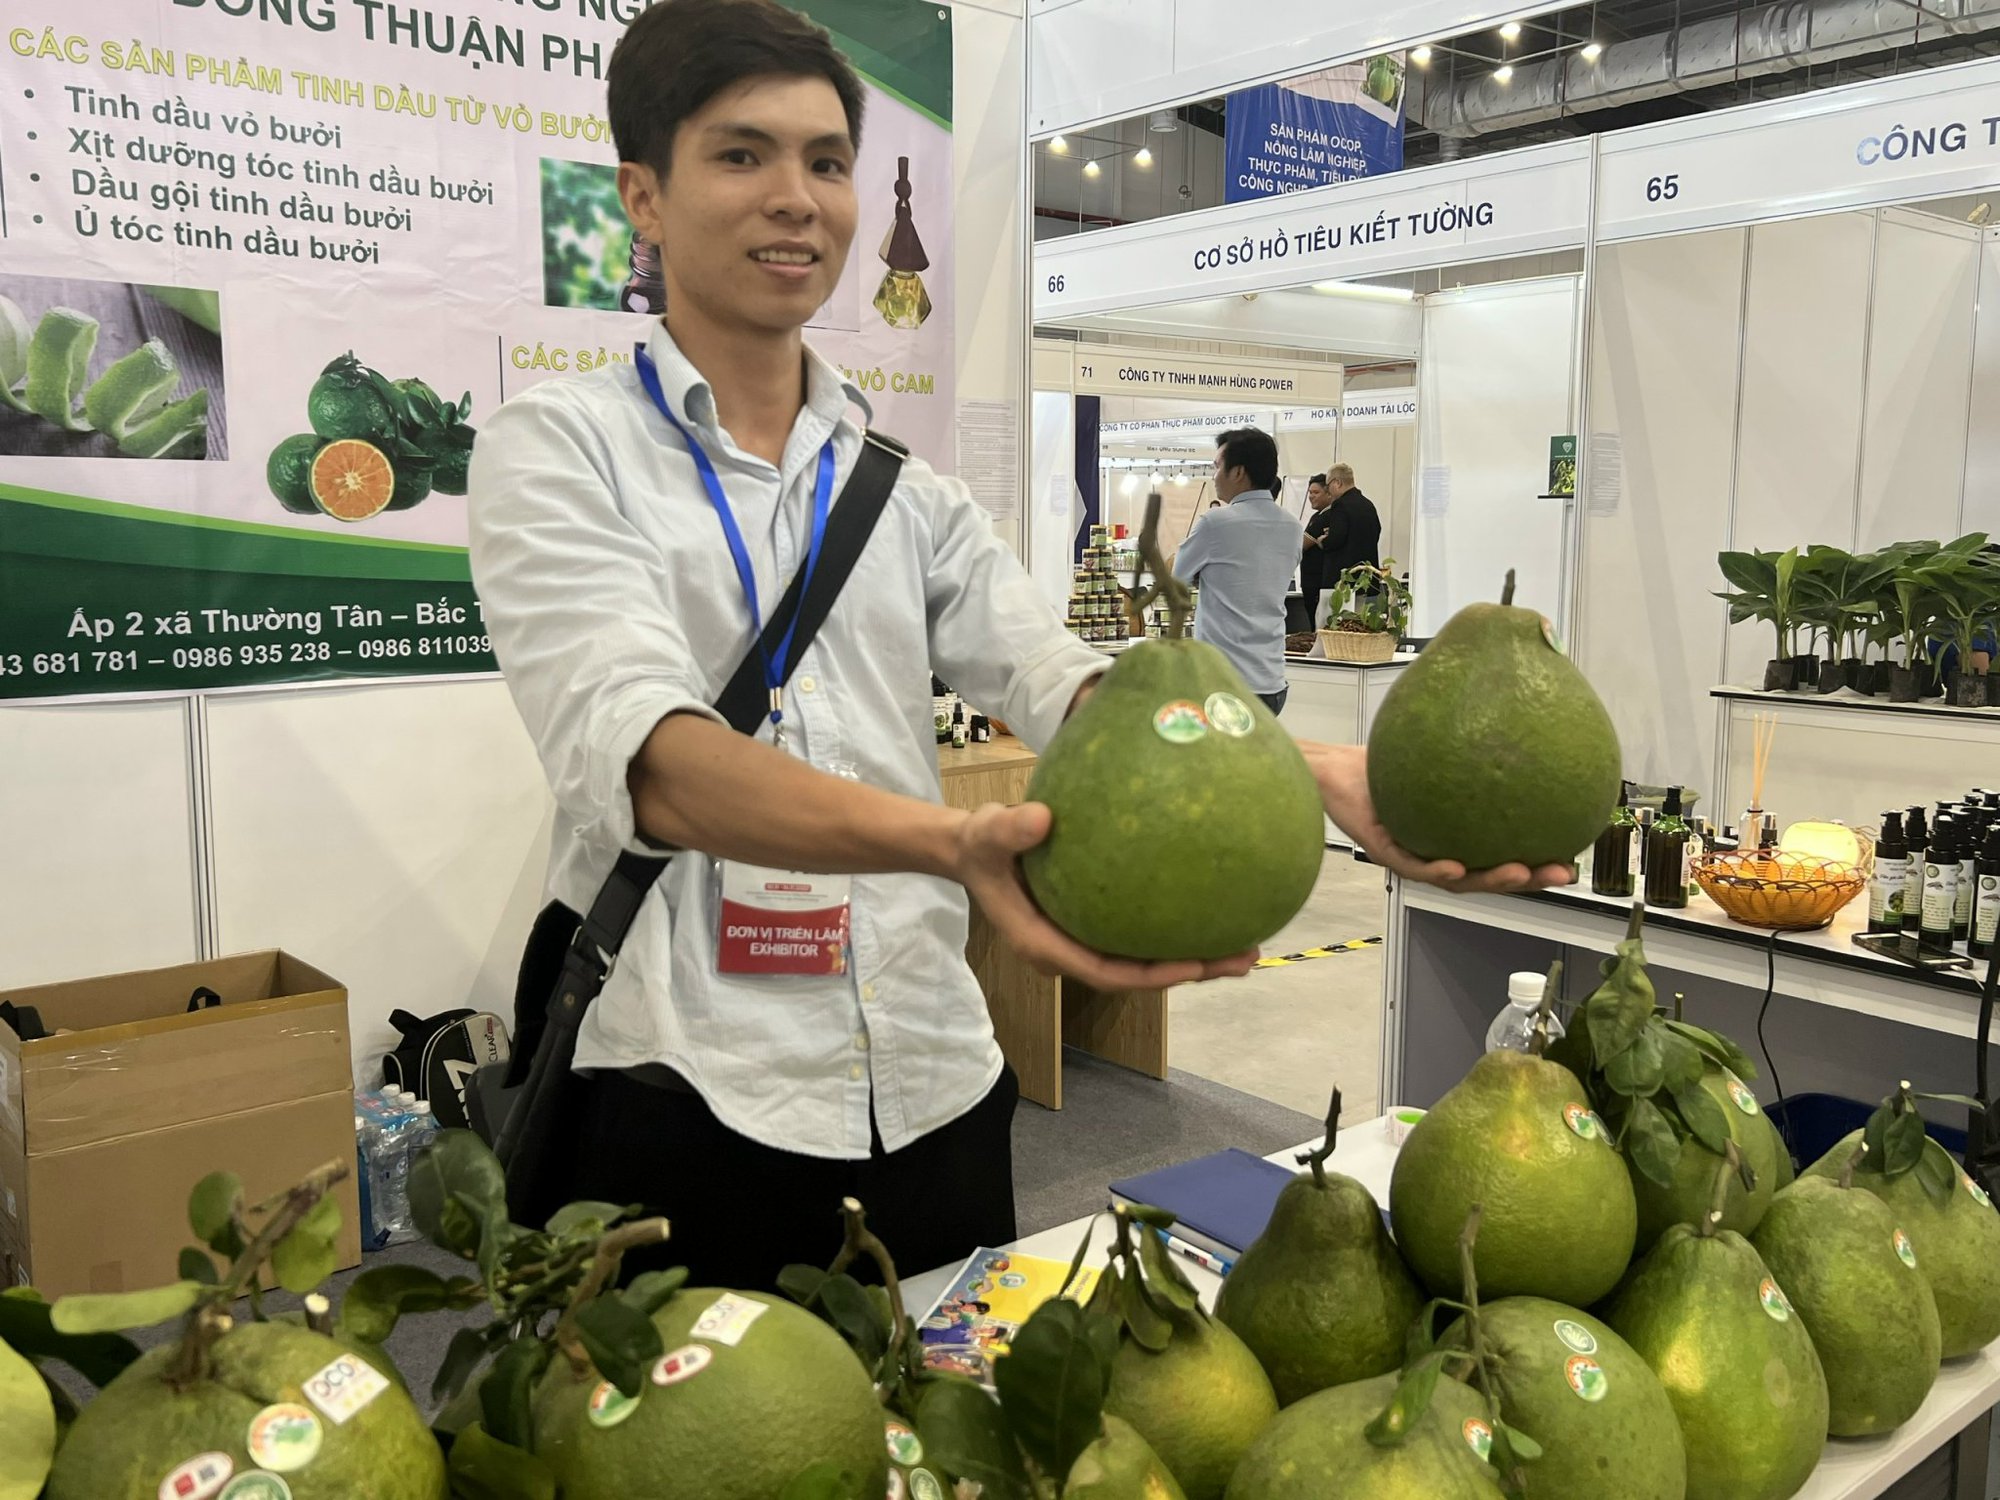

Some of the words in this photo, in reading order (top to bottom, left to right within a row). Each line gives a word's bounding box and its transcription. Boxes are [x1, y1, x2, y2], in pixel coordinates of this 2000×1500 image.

[173, 0, 335, 31] NG
[352, 1, 524, 70] THUẬN
[543, 33, 608, 81] PH
[9, 26, 89, 64] CÁC
[101, 39, 174, 76] SẢN
[186, 56, 282, 95] PHẨM
[291, 71, 364, 107] TINH
[373, 83, 436, 118] DẦU
[444, 94, 486, 125] TỪ
[492, 103, 532, 132] VỎ
[64, 85, 140, 120] Tinh
[152, 95, 210, 130] dầu
[221, 111, 259, 138] vỏ
[270, 115, 341, 149] bưởi
[1270, 122, 1293, 140] SẢN
[68, 127, 115, 163] Xịt
[126, 136, 235, 179] dưỡng
[245, 152, 294, 180] tóc
[303, 160, 359, 189] tinh
[369, 164, 420, 196] dầu
[430, 175, 493, 205] bưởi
[1248, 156, 1281, 174] THỰC
[1264, 140, 1297, 159] NÔNG
[1300, 147, 1324, 164] LÂM
[1646, 174, 1680, 202] 65
[1856, 124, 1967, 165] CÔNG
[72, 166, 138, 201] Dầu
[150, 180, 199, 212] gội
[209, 187, 269, 216] tinh
[279, 191, 334, 223] dầu
[345, 201, 411, 232] bưởi
[1238, 173, 1274, 192] CÔNG
[75, 204, 98, 237] Ủ
[110, 215, 164, 243] tóc
[174, 221, 233, 250] tinh
[243, 225, 299, 257] dầu
[310, 235, 379, 264] bưởi
[1048, 275, 1065, 293] 66
[1194, 244, 1221, 271] CƠ
[1226, 236, 1253, 266] SỞ
[1259, 228, 1288, 260] HỒ
[1294, 225, 1342, 255] TIÊU
[1350, 209, 1401, 246] KIẾT
[1407, 202, 1493, 236] TƯỜNG
[511, 342, 568, 371] CÁC
[856, 367, 886, 391] VỎ
[891, 372, 934, 395] CAM
[1081, 366, 1093, 378] 71
[1118, 367, 1149, 382] CÔNG
[1152, 371, 1165, 383] TY
[1168, 372, 1196, 385] TNHH
[1198, 374, 1227, 388] MẠNH
[1229, 373, 1257, 389] HÙNG
[1259, 378, 1293, 391] POWER
[1284, 412, 1293, 420] 77
[1347, 406, 1377, 416] DOANH
[67, 607, 115, 643] Ấp
[125, 611, 144, 636] 2
[154, 610, 192, 635] xã
[200, 608, 322, 635] Thường
[330, 604, 382, 628] Tân
[416, 597, 466, 625] Bắc
[33, 652, 80, 675] 681
[91, 650, 138, 672] 781
[172, 646, 232, 669] 0986
[239, 644, 283, 665] 935
[290, 642, 331, 662] 238
[358, 638, 411, 658] 0986
[418, 635, 491, 655] 811039
[727, 925, 758, 939] ĐƠN
[759, 926, 772, 941] VỊ
[750, 942, 818, 957] EXHIBITOR
